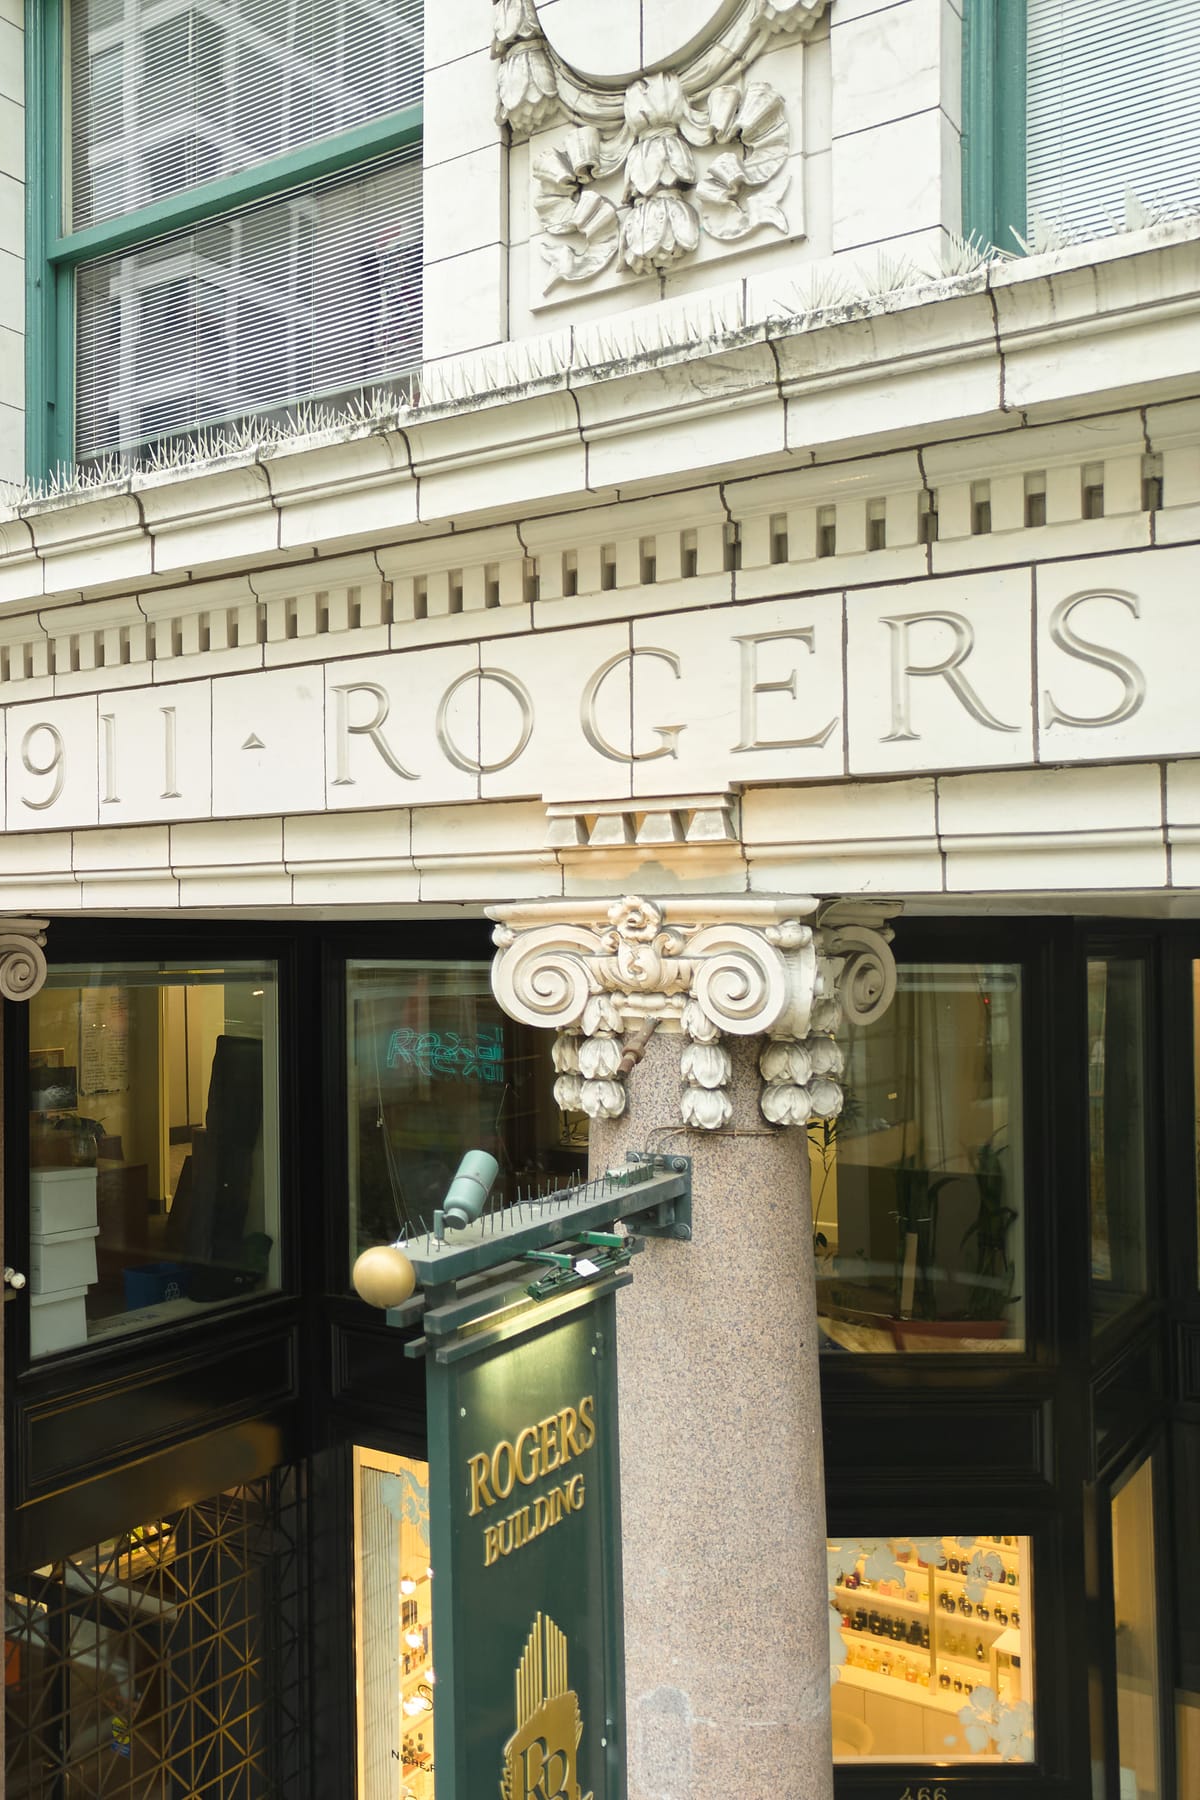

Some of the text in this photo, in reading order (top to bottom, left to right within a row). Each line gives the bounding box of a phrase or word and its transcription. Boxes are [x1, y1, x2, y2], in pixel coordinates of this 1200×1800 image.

[329, 587, 1146, 788] ROGERS
[467, 1394, 596, 1518] ROGERS
[483, 1473, 587, 1568] BUILDING
